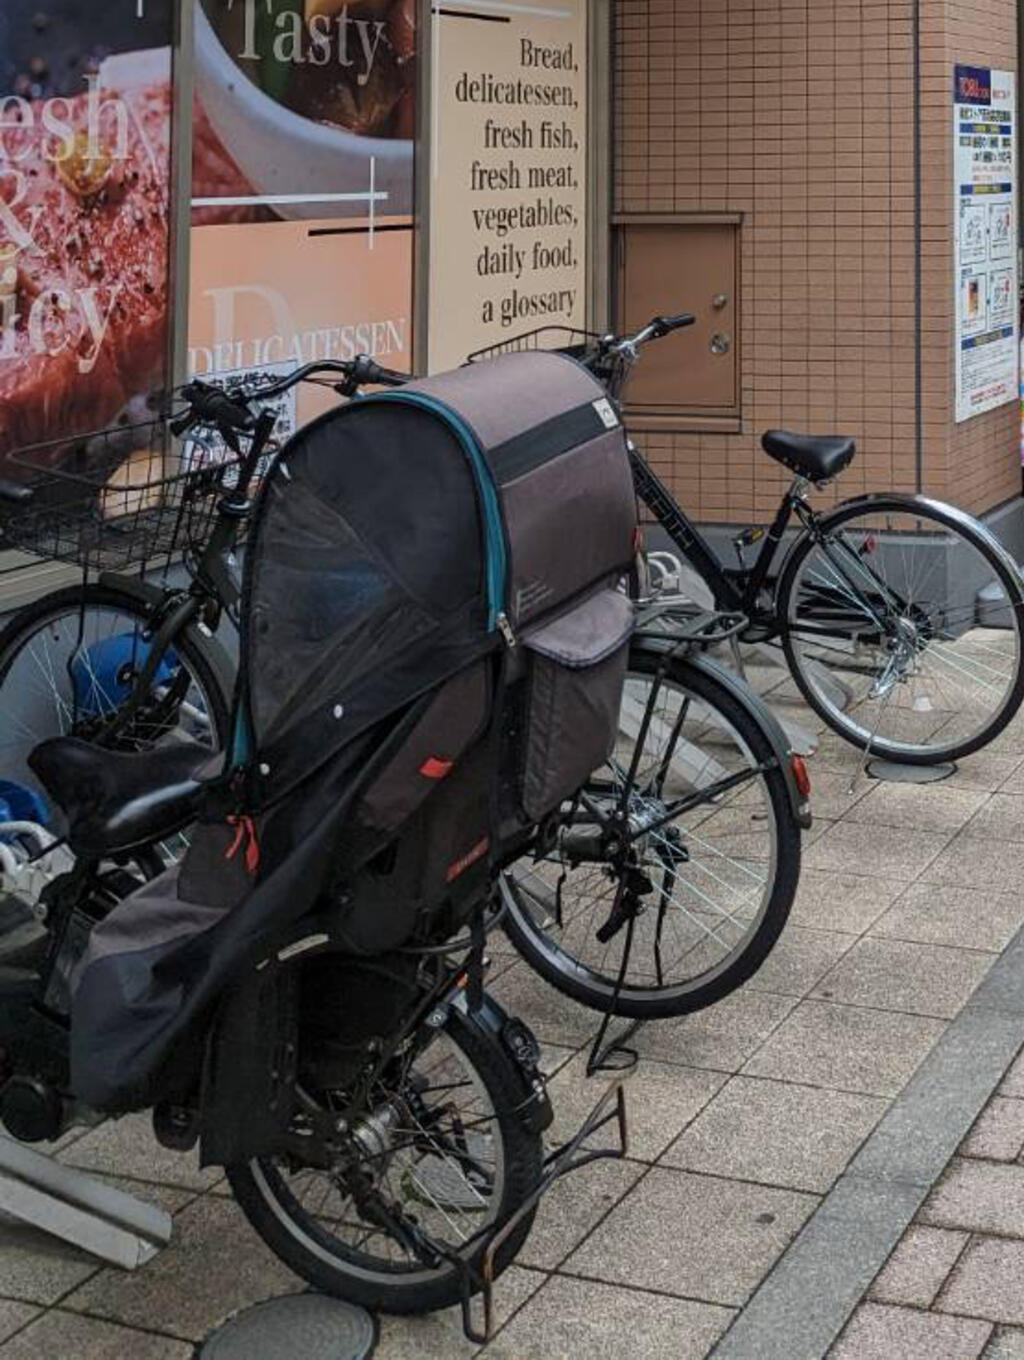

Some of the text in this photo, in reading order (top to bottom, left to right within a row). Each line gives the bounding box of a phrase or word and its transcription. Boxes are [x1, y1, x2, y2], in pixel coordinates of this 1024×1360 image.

[520, 38, 578, 73] Bread,
[455, 72, 578, 109] delicatessen,
[484, 118, 578, 152] fresh fish,
[471, 159, 578, 191] fresh meat,
[472, 197, 578, 237] vegetables,
[477, 238, 577, 279] daily food,
[482, 288, 576, 328] a glossary
